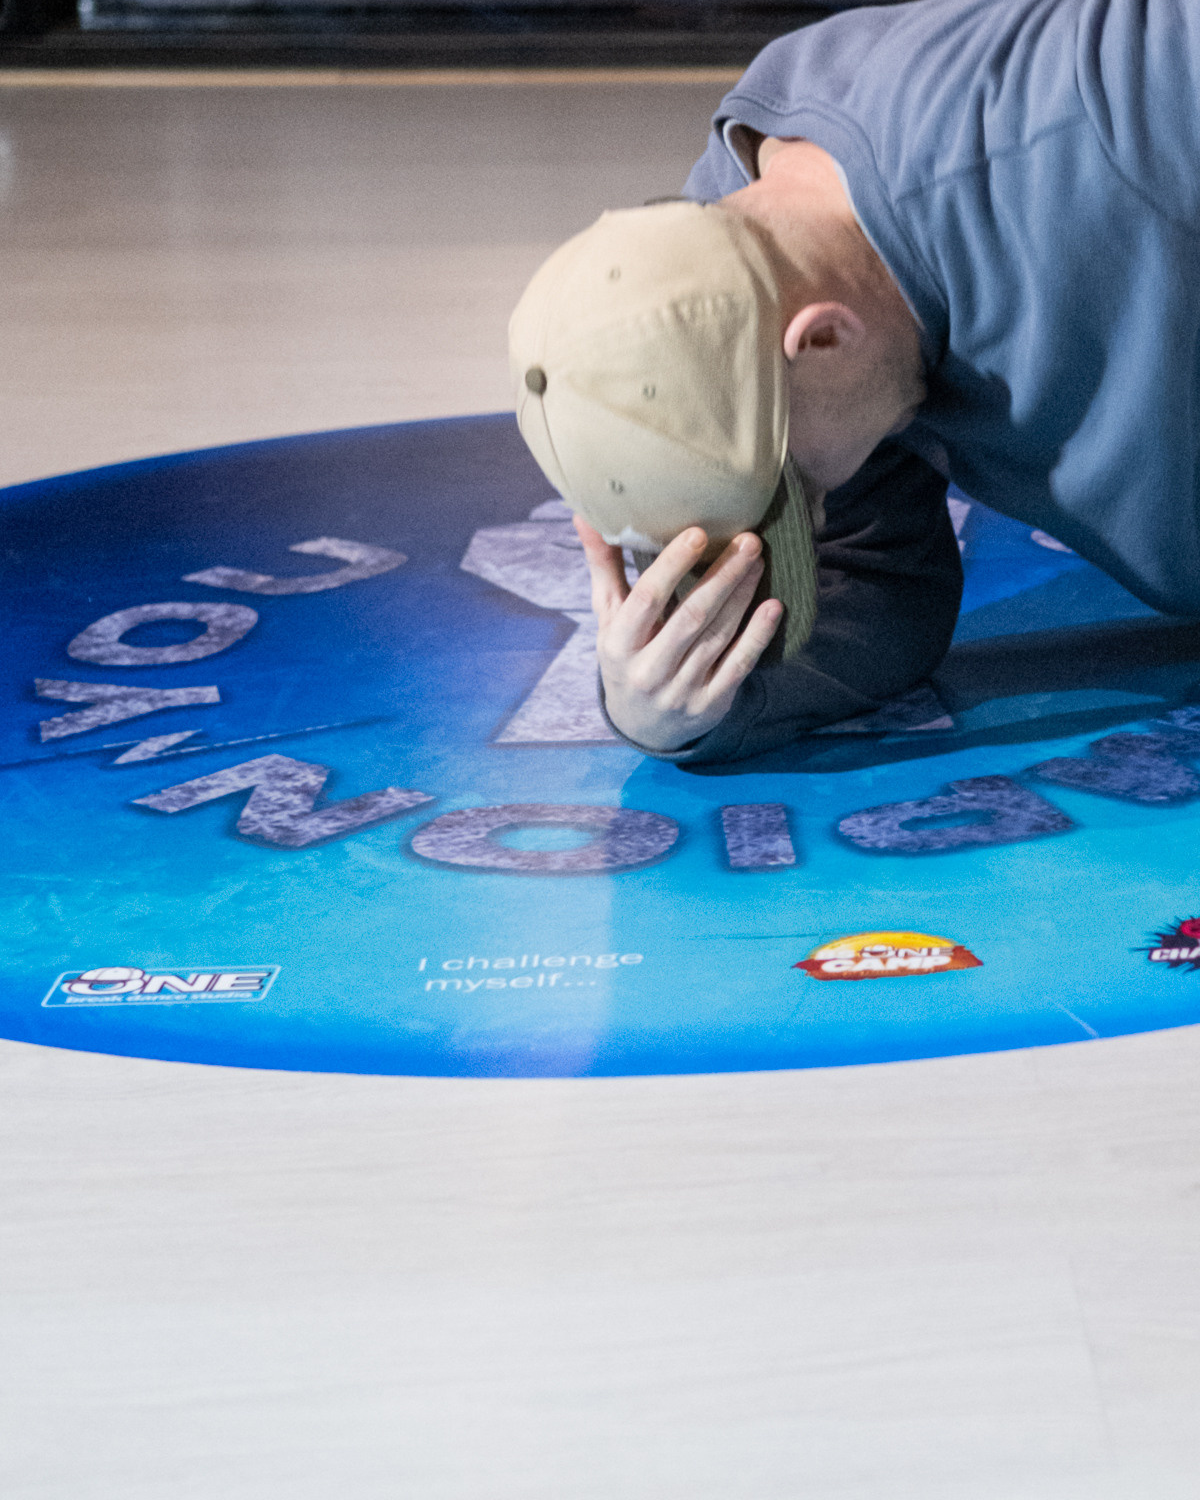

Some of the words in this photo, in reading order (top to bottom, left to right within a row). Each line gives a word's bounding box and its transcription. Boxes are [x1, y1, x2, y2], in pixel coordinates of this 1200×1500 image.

[418, 957, 427, 972] I
[442, 953, 644, 971] challenge
[821, 956, 951, 973] CAMP
[61, 970, 271, 995] ONE
[425, 972, 597, 993] myself...
